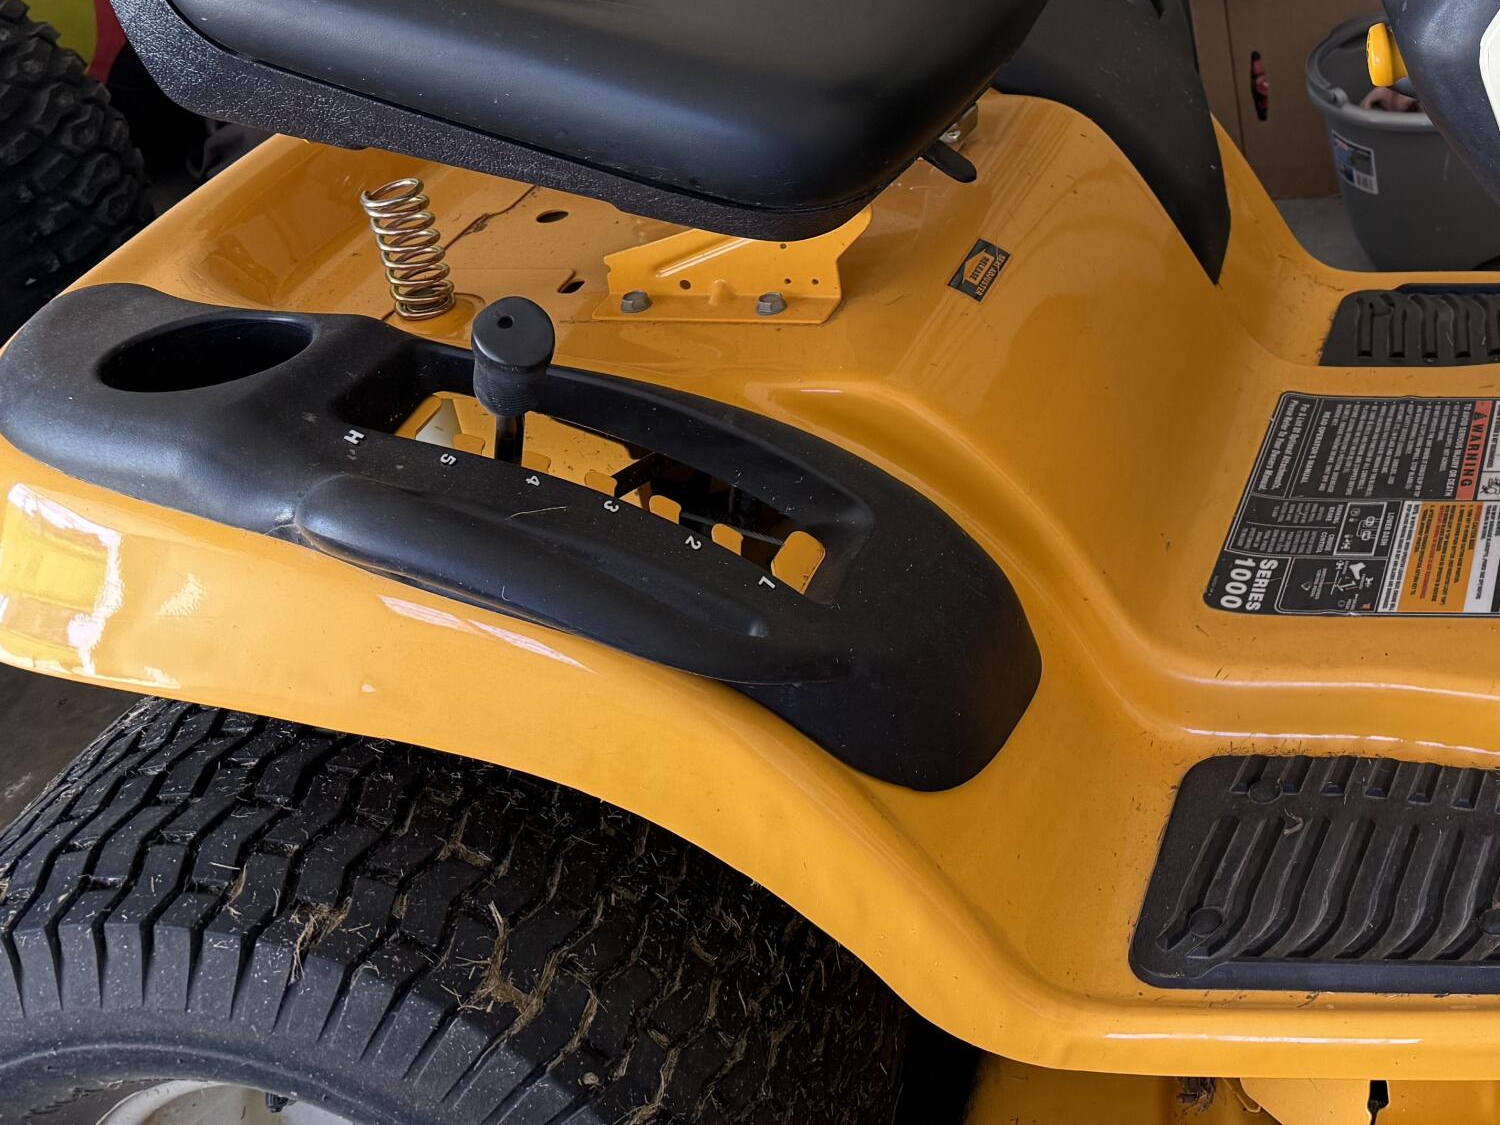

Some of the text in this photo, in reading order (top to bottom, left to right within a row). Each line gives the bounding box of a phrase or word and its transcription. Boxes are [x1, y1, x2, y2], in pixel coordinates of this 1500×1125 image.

[1284, 399, 1299, 415] Please
[1279, 416, 1293, 430] Refer
[1319, 411, 1331, 425] READ
[343, 428, 366, 446] H
[1272, 437, 1285, 449] Your
[1282, 433, 1300, 455] Optional
[1454, 426, 1467, 448] SERIOUS
[440, 452, 457, 467] 5
[1449, 449, 1462, 469] INJURY
[1459, 423, 1484, 487] WARNING
[1299, 459, 1315, 483] MANUAL
[1447, 469, 1458, 477] OR
[525, 474, 541, 489] 4
[1443, 478, 1456, 496] DEATH
[603, 499, 620, 514] 3
[1379, 511, 1395, 546] LOWER DASH
[684, 534, 702, 552] 2
[1314, 531, 1328, 553] CONTROL
[1216, 557, 1258, 609] 1000
[1243, 558, 1280, 611] SERIES
